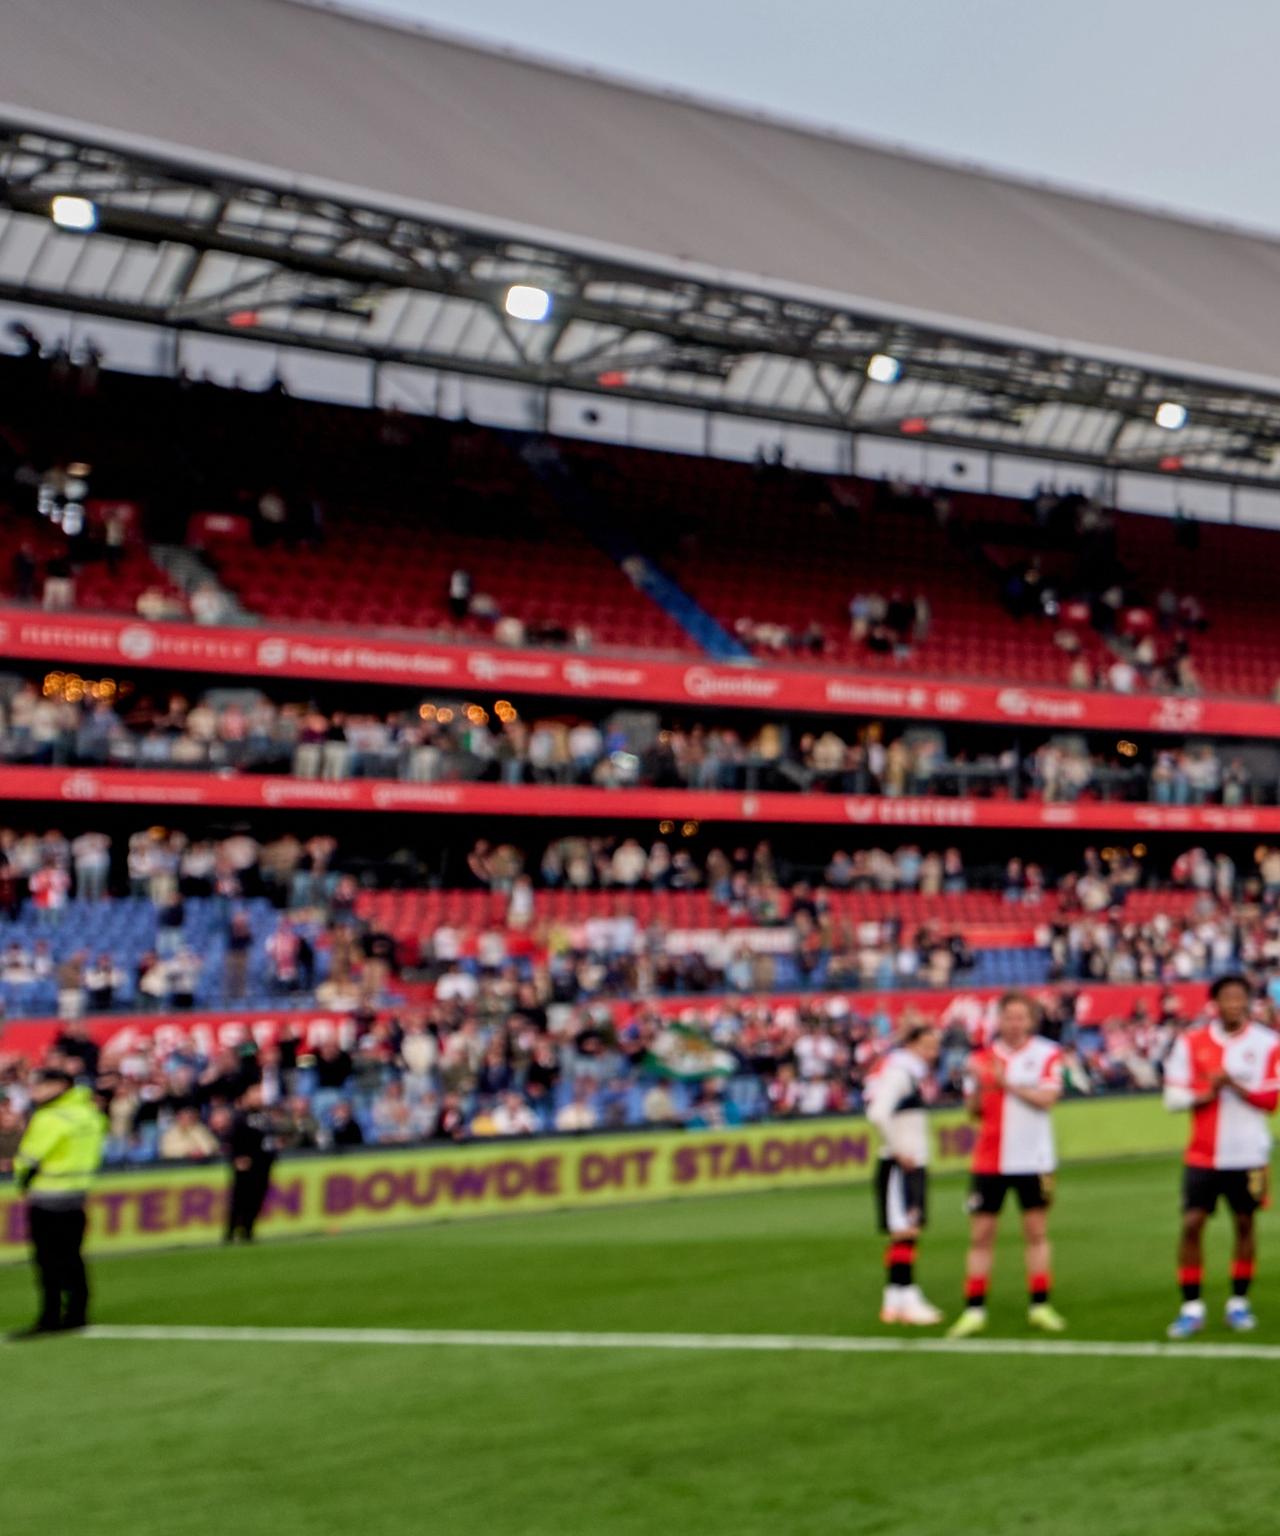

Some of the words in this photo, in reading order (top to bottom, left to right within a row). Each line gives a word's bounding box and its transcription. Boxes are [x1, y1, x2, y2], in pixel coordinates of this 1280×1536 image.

[323, 1155, 562, 1215] BOUWDE
[578, 1146, 658, 1194] DIT
[673, 1134, 871, 1184] STADION
